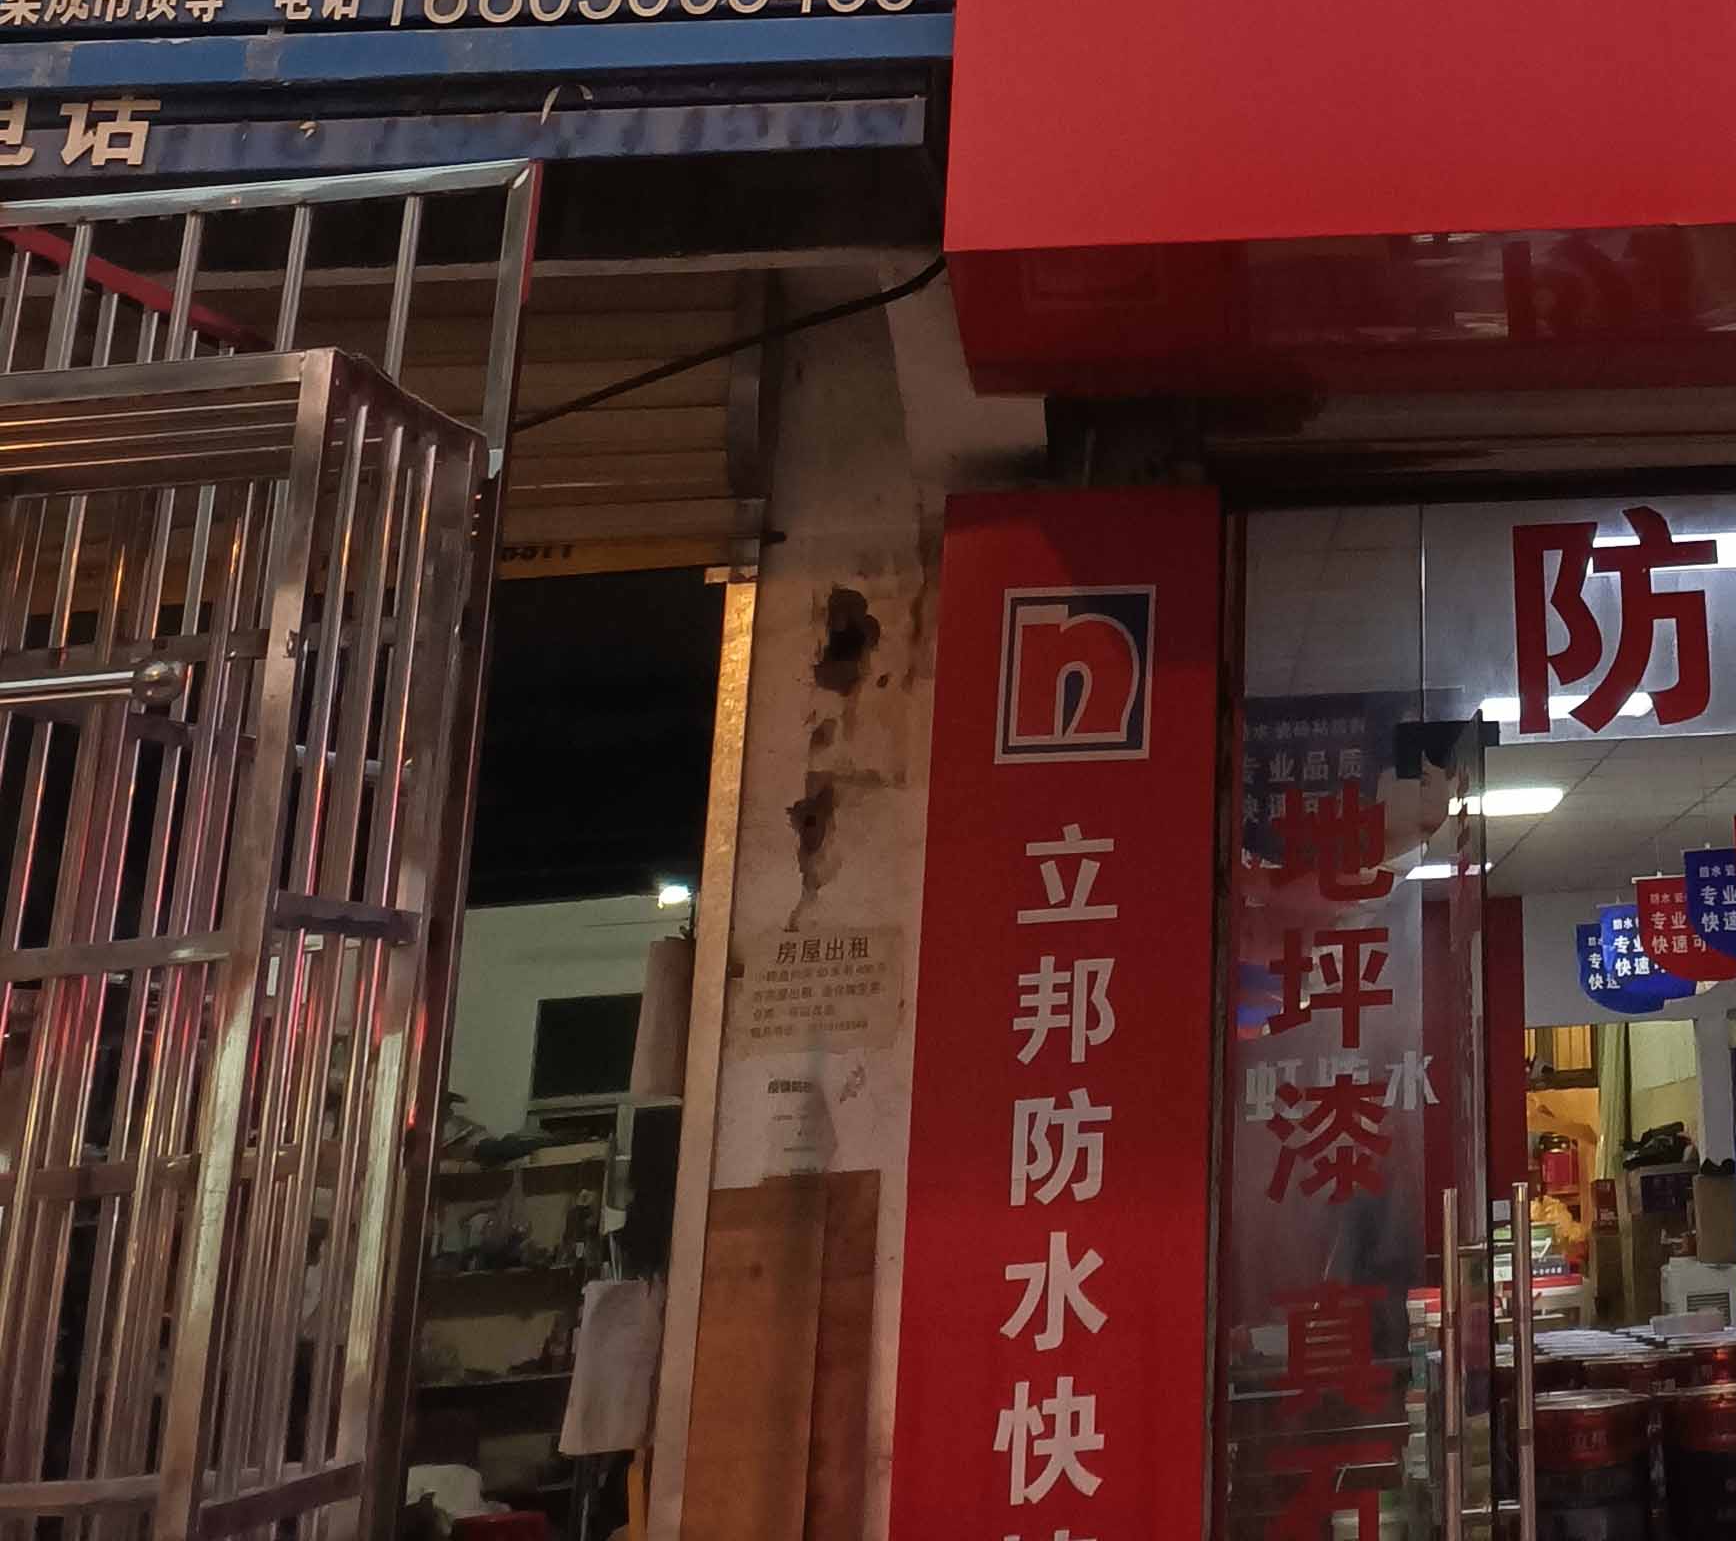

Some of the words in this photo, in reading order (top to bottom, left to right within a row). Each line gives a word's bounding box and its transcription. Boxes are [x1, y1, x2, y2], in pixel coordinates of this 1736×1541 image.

[777, 937, 869, 963] 房屋出租
[1268, 778, 1396, 1205] 地坪漆
[991, 823, 1118, 1541] 立邦防水快
